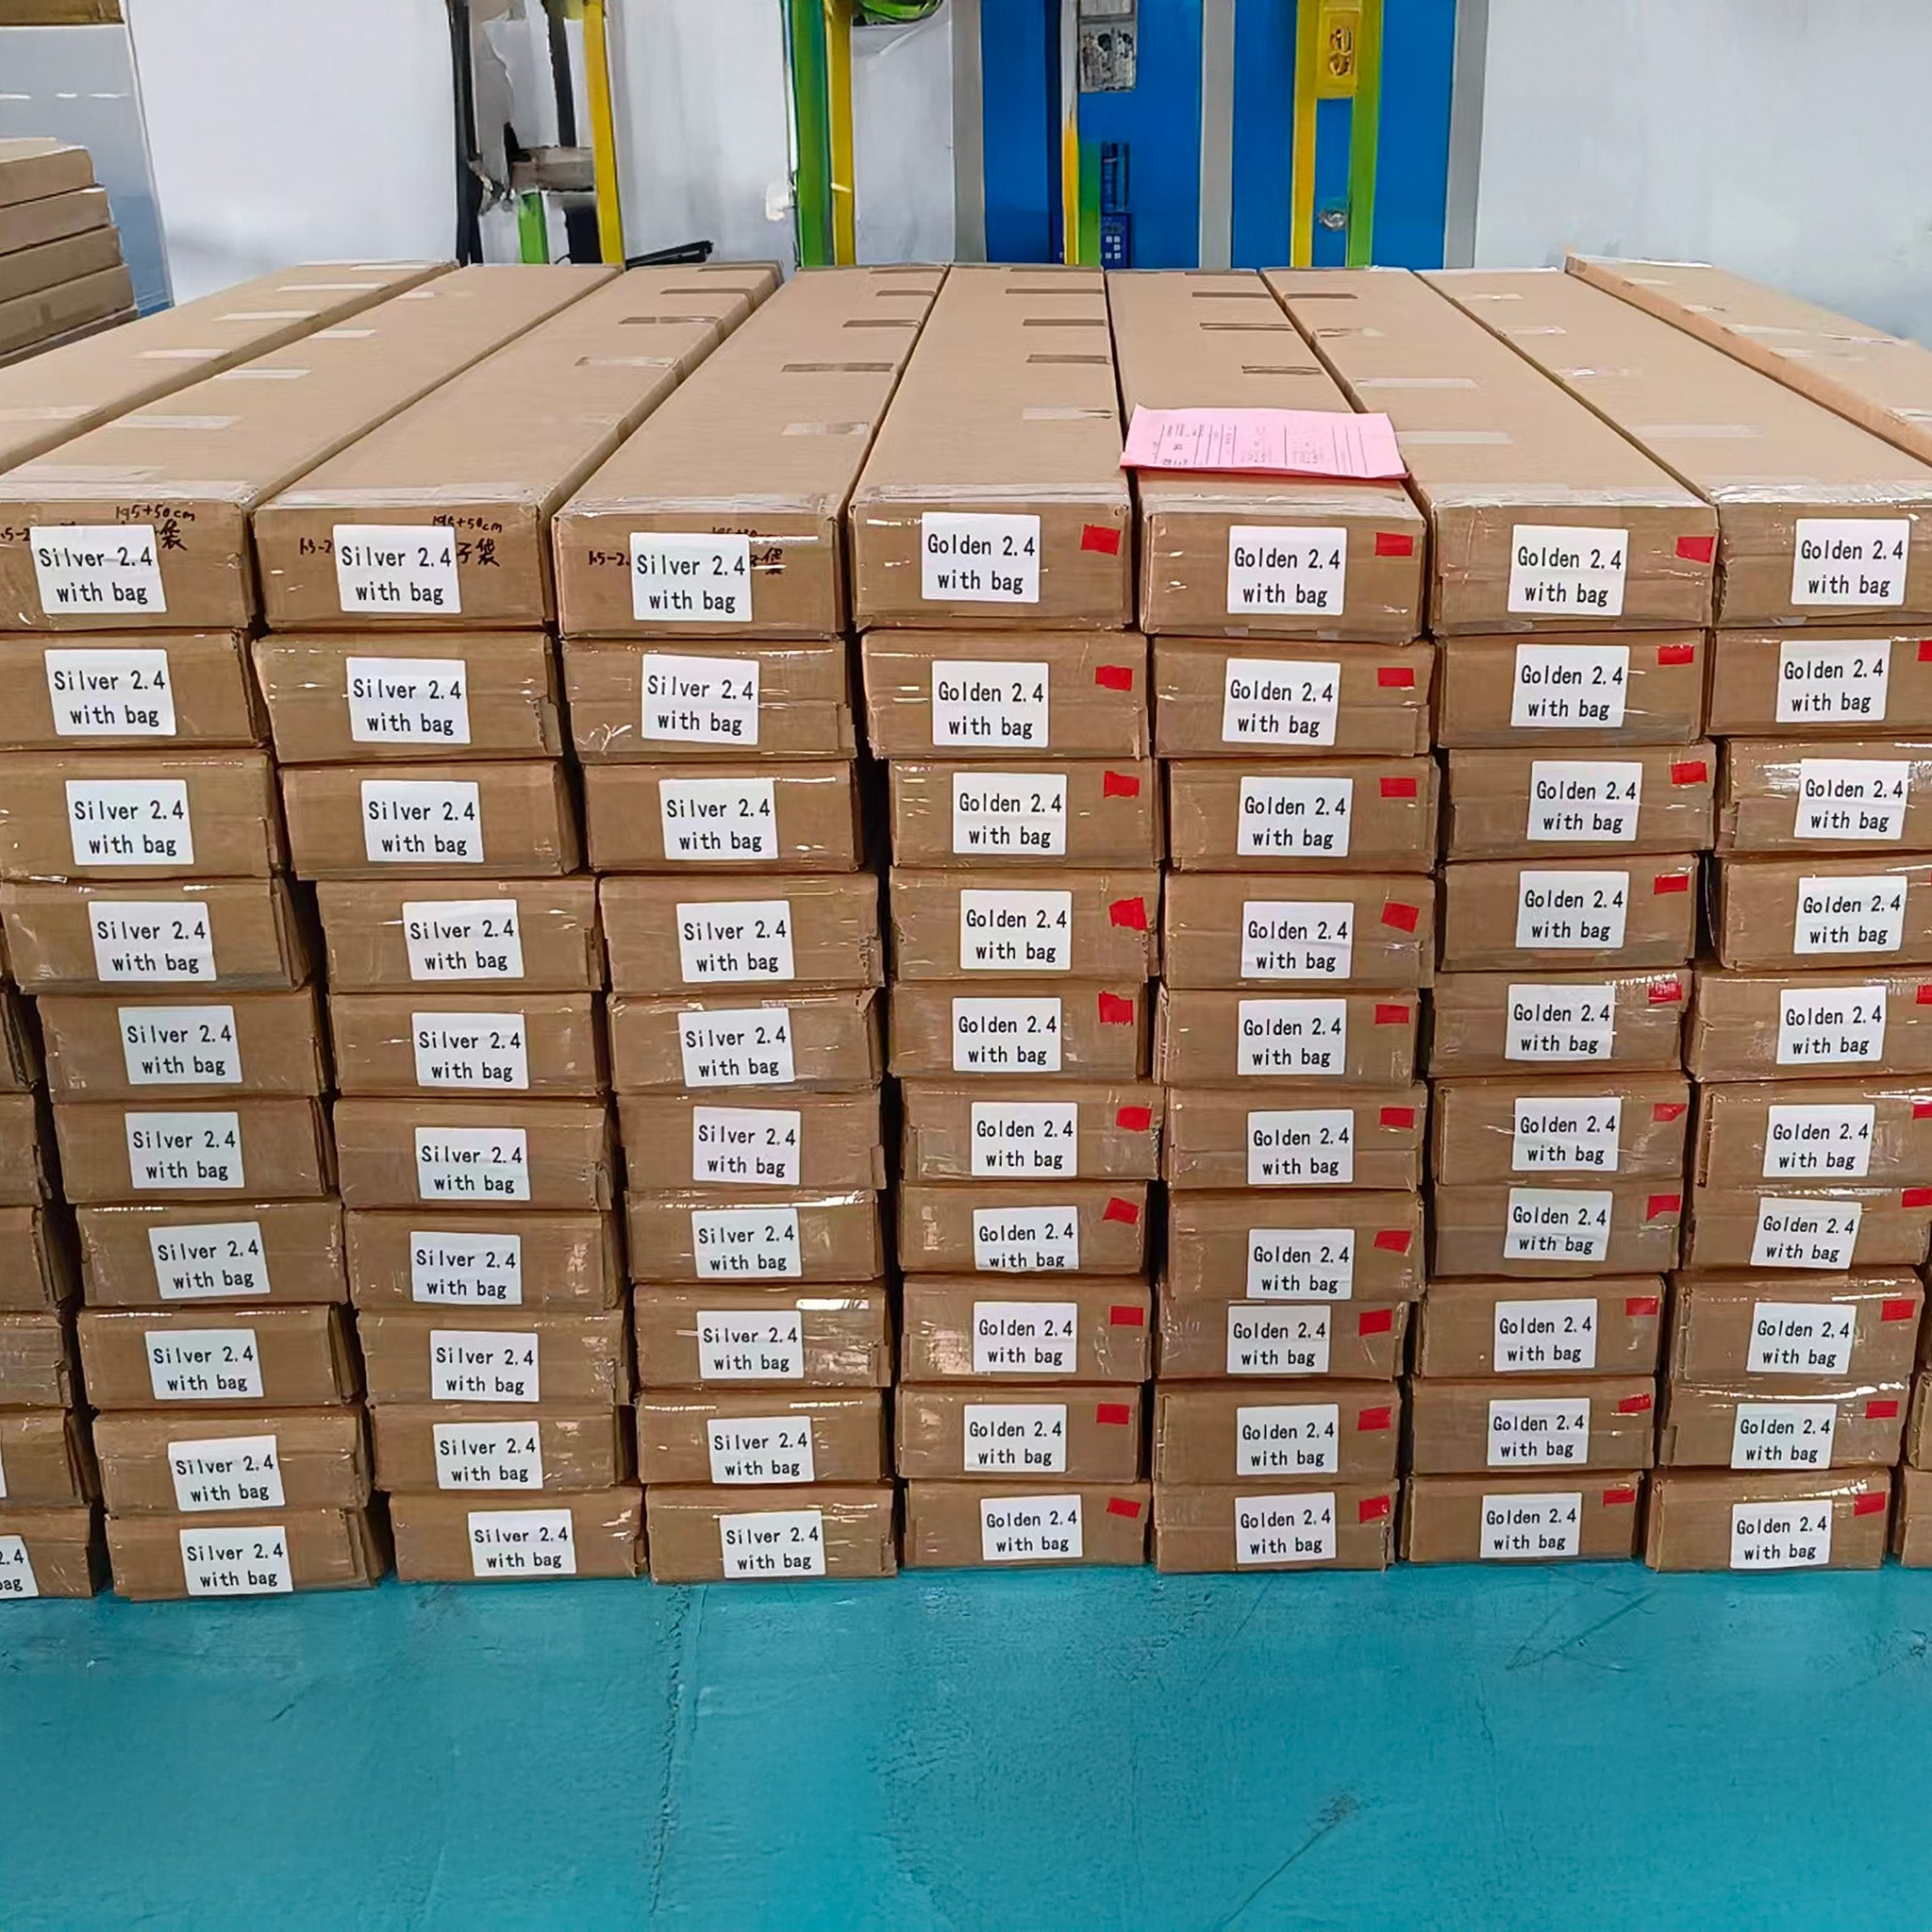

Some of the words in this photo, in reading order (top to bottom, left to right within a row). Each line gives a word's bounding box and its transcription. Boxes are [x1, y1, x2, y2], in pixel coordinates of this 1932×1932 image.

[38, 547, 106, 568] Silver
[116, 545, 153, 568] 2.4
[341, 545, 407, 567] Silver
[417, 546, 452, 568] 2.4
[927, 533, 991, 556] Golden
[1002, 535, 1036, 558] 2.4
[1801, 539, 1863, 560] Golden
[1872, 539, 1904, 560] 2.4
[637, 554, 701, 576] Silver
[711, 555, 746, 576] 2.4
[1234, 546, 1298, 569] Golden
[1307, 548, 1341, 570] 2.4
[1517, 545, 1580, 569] Golden
[1590, 548, 1622, 571] 2.4
[937, 569, 981, 591] with
[991, 570, 1024, 595] bag
[1807, 574, 1850, 594] with
[1858, 574, 1891, 598] bag
[56, 581, 104, 603] with
[111, 581, 149, 606] bag
[355, 580, 401, 602] with
[409, 581, 444, 607] bag
[648, 589, 693, 610] with
[702, 590, 736, 614] bag
[1242, 582, 1286, 604] with
[1295, 583, 1328, 608] bag
[1524, 581, 1567, 603] with
[1575, 582, 1609, 608] bag
[1521, 664, 1582, 685] Golden
[1591, 665, 1624, 686] 2.4
[1784, 659, 1844, 680] Golden
[1852, 658, 1884, 678] 2.4
[54, 670, 120, 691] Silver
[130, 670, 166, 691] 2.4
[353, 677, 417, 700] Silver
[427, 679, 462, 700] 2.4
[647, 675, 710, 698] Silver
[721, 678, 754, 701] 2.4
[938, 680, 1002, 703] Golden
[1011, 682, 1044, 703] 2.4
[1229, 678, 1292, 702] Golden
[1301, 681, 1334, 703] 2.4
[1527, 697, 1569, 718] with
[1578, 698, 1610, 722] bag
[1791, 691, 1832, 712] with
[1840, 691, 1872, 714] bag
[69, 704, 116, 724] with
[124, 704, 160, 728] bag
[366, 711, 411, 732] with
[420, 712, 455, 737] bag
[657, 709, 700, 731] with
[709, 711, 743, 737] bag
[1237, 712, 1279, 733] with
[1288, 714, 1321, 739] bag
[948, 715, 991, 736] with
[1001, 716, 1033, 741] bag
[74, 800, 139, 821] Silver
[149, 799, 185, 821] 2.4
[666, 798, 727, 819] Silver
[738, 797, 771, 818] 2.4
[1244, 795, 1306, 816] Golden
[1314, 796, 1346, 816] 2.4
[88, 833, 134, 855] with
[142, 833, 177, 858] bag
[678, 830, 722, 851] with
[730, 830, 762, 853] bag
[1252, 827, 1293, 847] with
[1302, 827, 1334, 851] bag
[1803, 895, 1862, 914] Golden
[1870, 893, 1901, 912] 2.4
[409, 921, 472, 941] Silver
[481, 918, 515, 939] 2.4
[966, 908, 1026, 928] Golden
[1036, 908, 1068, 929] 2.4
[1809, 924, 1849, 944] with
[1857, 924, 1889, 946] bag
[424, 950, 467, 971] with
[475, 950, 508, 972] bag
[975, 941, 1016, 960] with
[1025, 941, 1057, 963] bag
[1513, 1003, 1572, 1023] Golden
[1580, 1004, 1610, 1023] 2.4
[126, 1024, 189, 1044] Silver
[198, 1024, 232, 1043] 2.4
[958, 1015, 1018, 1034] Golden
[1026, 1015, 1058, 1034] 2.4
[967, 1044, 1008, 1063] with
[1016, 1044, 1047, 1066] bag
[1520, 1033, 1560, 1052] with
[1568, 1034, 1599, 1055] bag
[141, 1055, 185, 1074] with
[192, 1055, 226, 1076] bag
[1253, 1128, 1311, 1147] Golden
[1320, 1126, 1350, 1145] 2.4
[1773, 1123, 1830, 1141] Golden
[1839, 1123, 1869, 1141] 2.4
[421, 1144, 481, 1164] Silver
[491, 1145, 523, 1164] 2.4
[1778, 1151, 1818, 1169] with
[1825, 1151, 1857, 1171] bag
[1261, 1158, 1302, 1176] with
[1309, 1157, 1340, 1177] bag
[433, 1174, 475, 1191] with
[483, 1174, 515, 1194] bag
[1512, 1205, 1569, 1225] Golden
[1577, 1208, 1607, 1226] 2.4
[698, 1226, 756, 1244] Silver
[764, 1224, 795, 1242] 2.4
[1519, 1234, 1557, 1252] with
[1564, 1235, 1594, 1256] bag
[157, 1242, 218, 1261] Silver
[226, 1239, 259, 1257] 2.4
[709, 1254, 749, 1272] with
[757, 1253, 788, 1272] bag
[172, 1271, 215, 1290] with
[221, 1269, 255, 1289] bag
[978, 1318, 1036, 1337] Golden
[1043, 1319, 1074, 1337] 2.4
[1757, 1319, 1813, 1338] Golden
[1821, 1321, 1850, 1339] 2.4
[436, 1346, 494, 1365] Silver
[504, 1348, 535, 1366] 2.4
[987, 1346, 1025, 1364] with
[1034, 1346, 1063, 1367] bag
[1762, 1347, 1800, 1365] with
[1807, 1348, 1838, 1369] bag
[445, 1374, 486, 1392] with
[494, 1375, 525, 1396] bag
[1241, 1423, 1298, 1441] Golden
[1306, 1421, 1335, 1439] 2.4
[1250, 1449, 1288, 1467] with
[1296, 1449, 1325, 1468] bag
[1486, 1508, 1541, 1525] Golden
[1548, 1507, 1577, 1524] 2.4
[474, 1527, 530, 1544] Silver
[539, 1525, 569, 1542] 2.4
[1493, 1534, 1530, 1551] with
[1538, 1533, 1567, 1551] bag
[486, 1552, 525, 1569] with
[532, 1551, 562, 1570] bag
